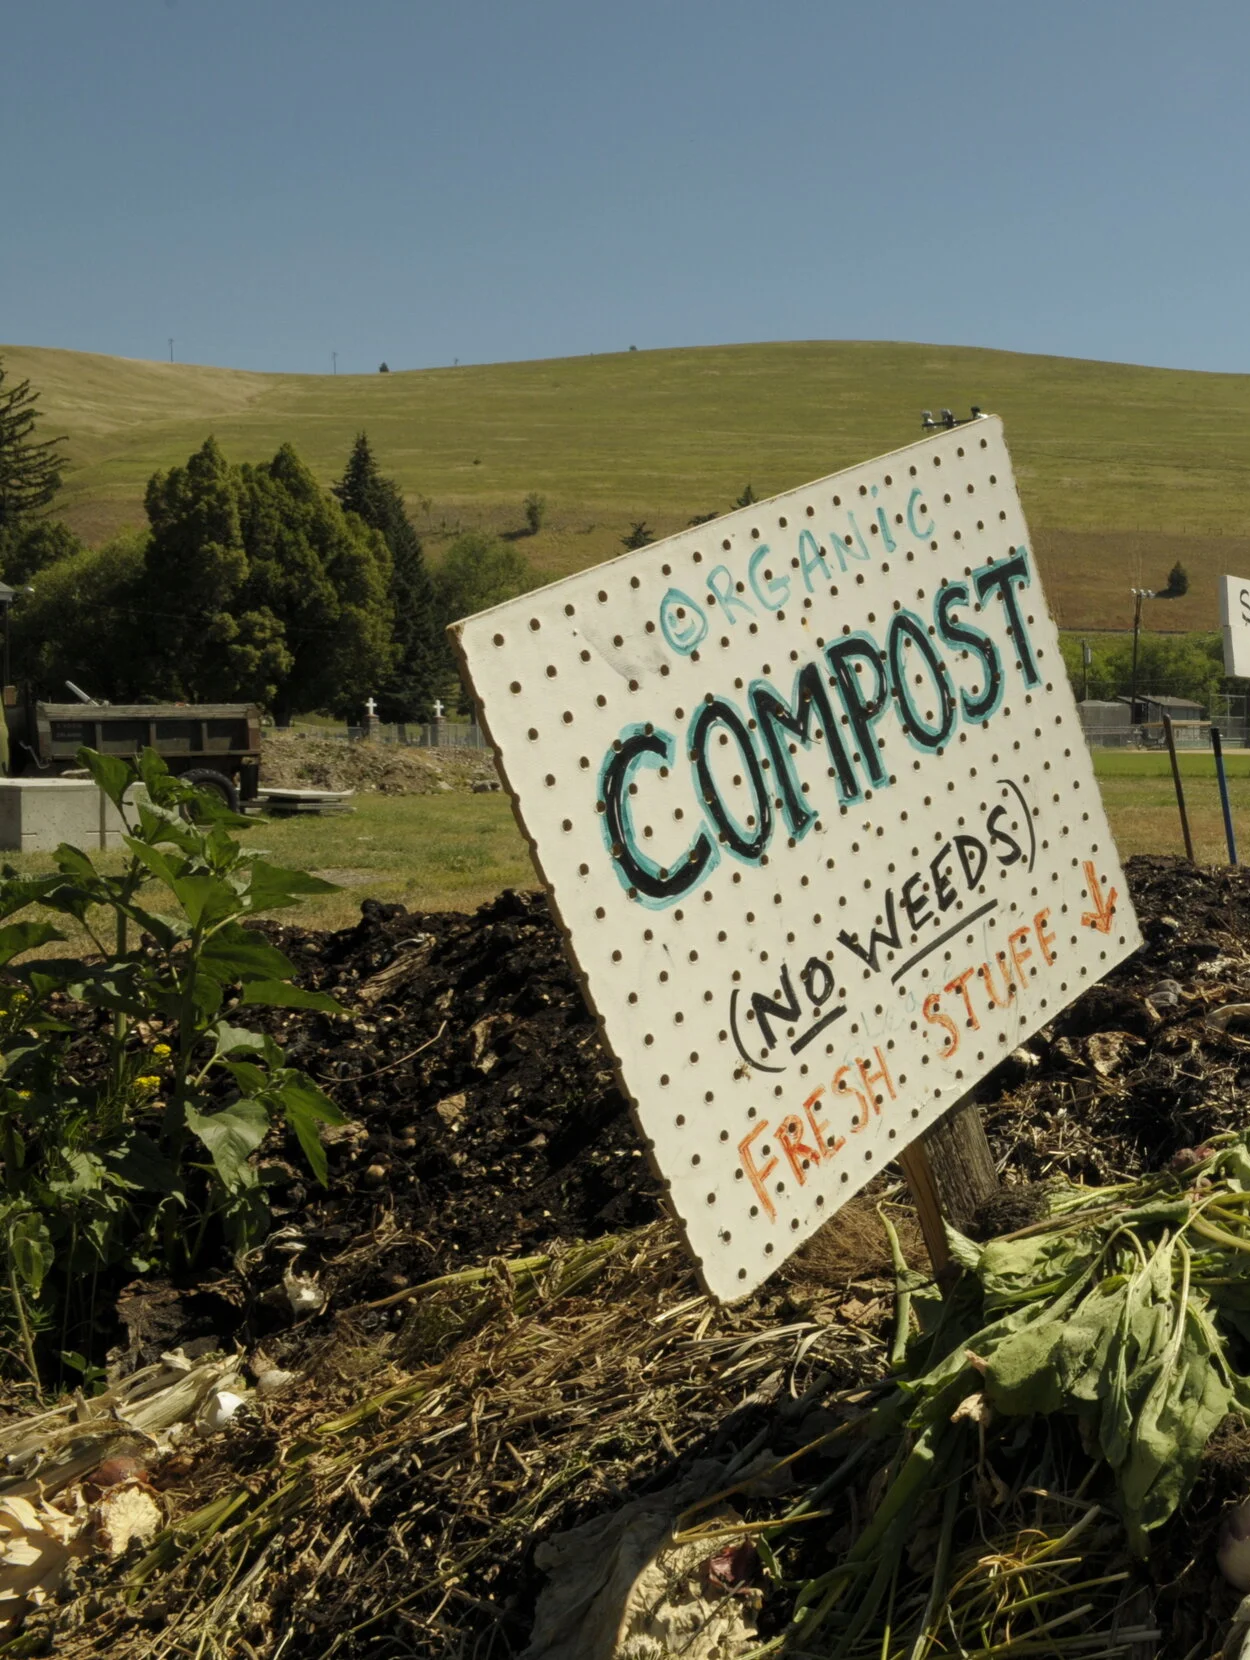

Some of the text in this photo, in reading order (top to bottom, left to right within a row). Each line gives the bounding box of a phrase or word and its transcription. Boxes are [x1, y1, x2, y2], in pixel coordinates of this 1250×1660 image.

[598, 546, 1041, 911] COMPOST
[836, 779, 1036, 972] WEEDS)
[738, 1046, 896, 1223] FRESH
[922, 907, 1056, 1059] STUFF
